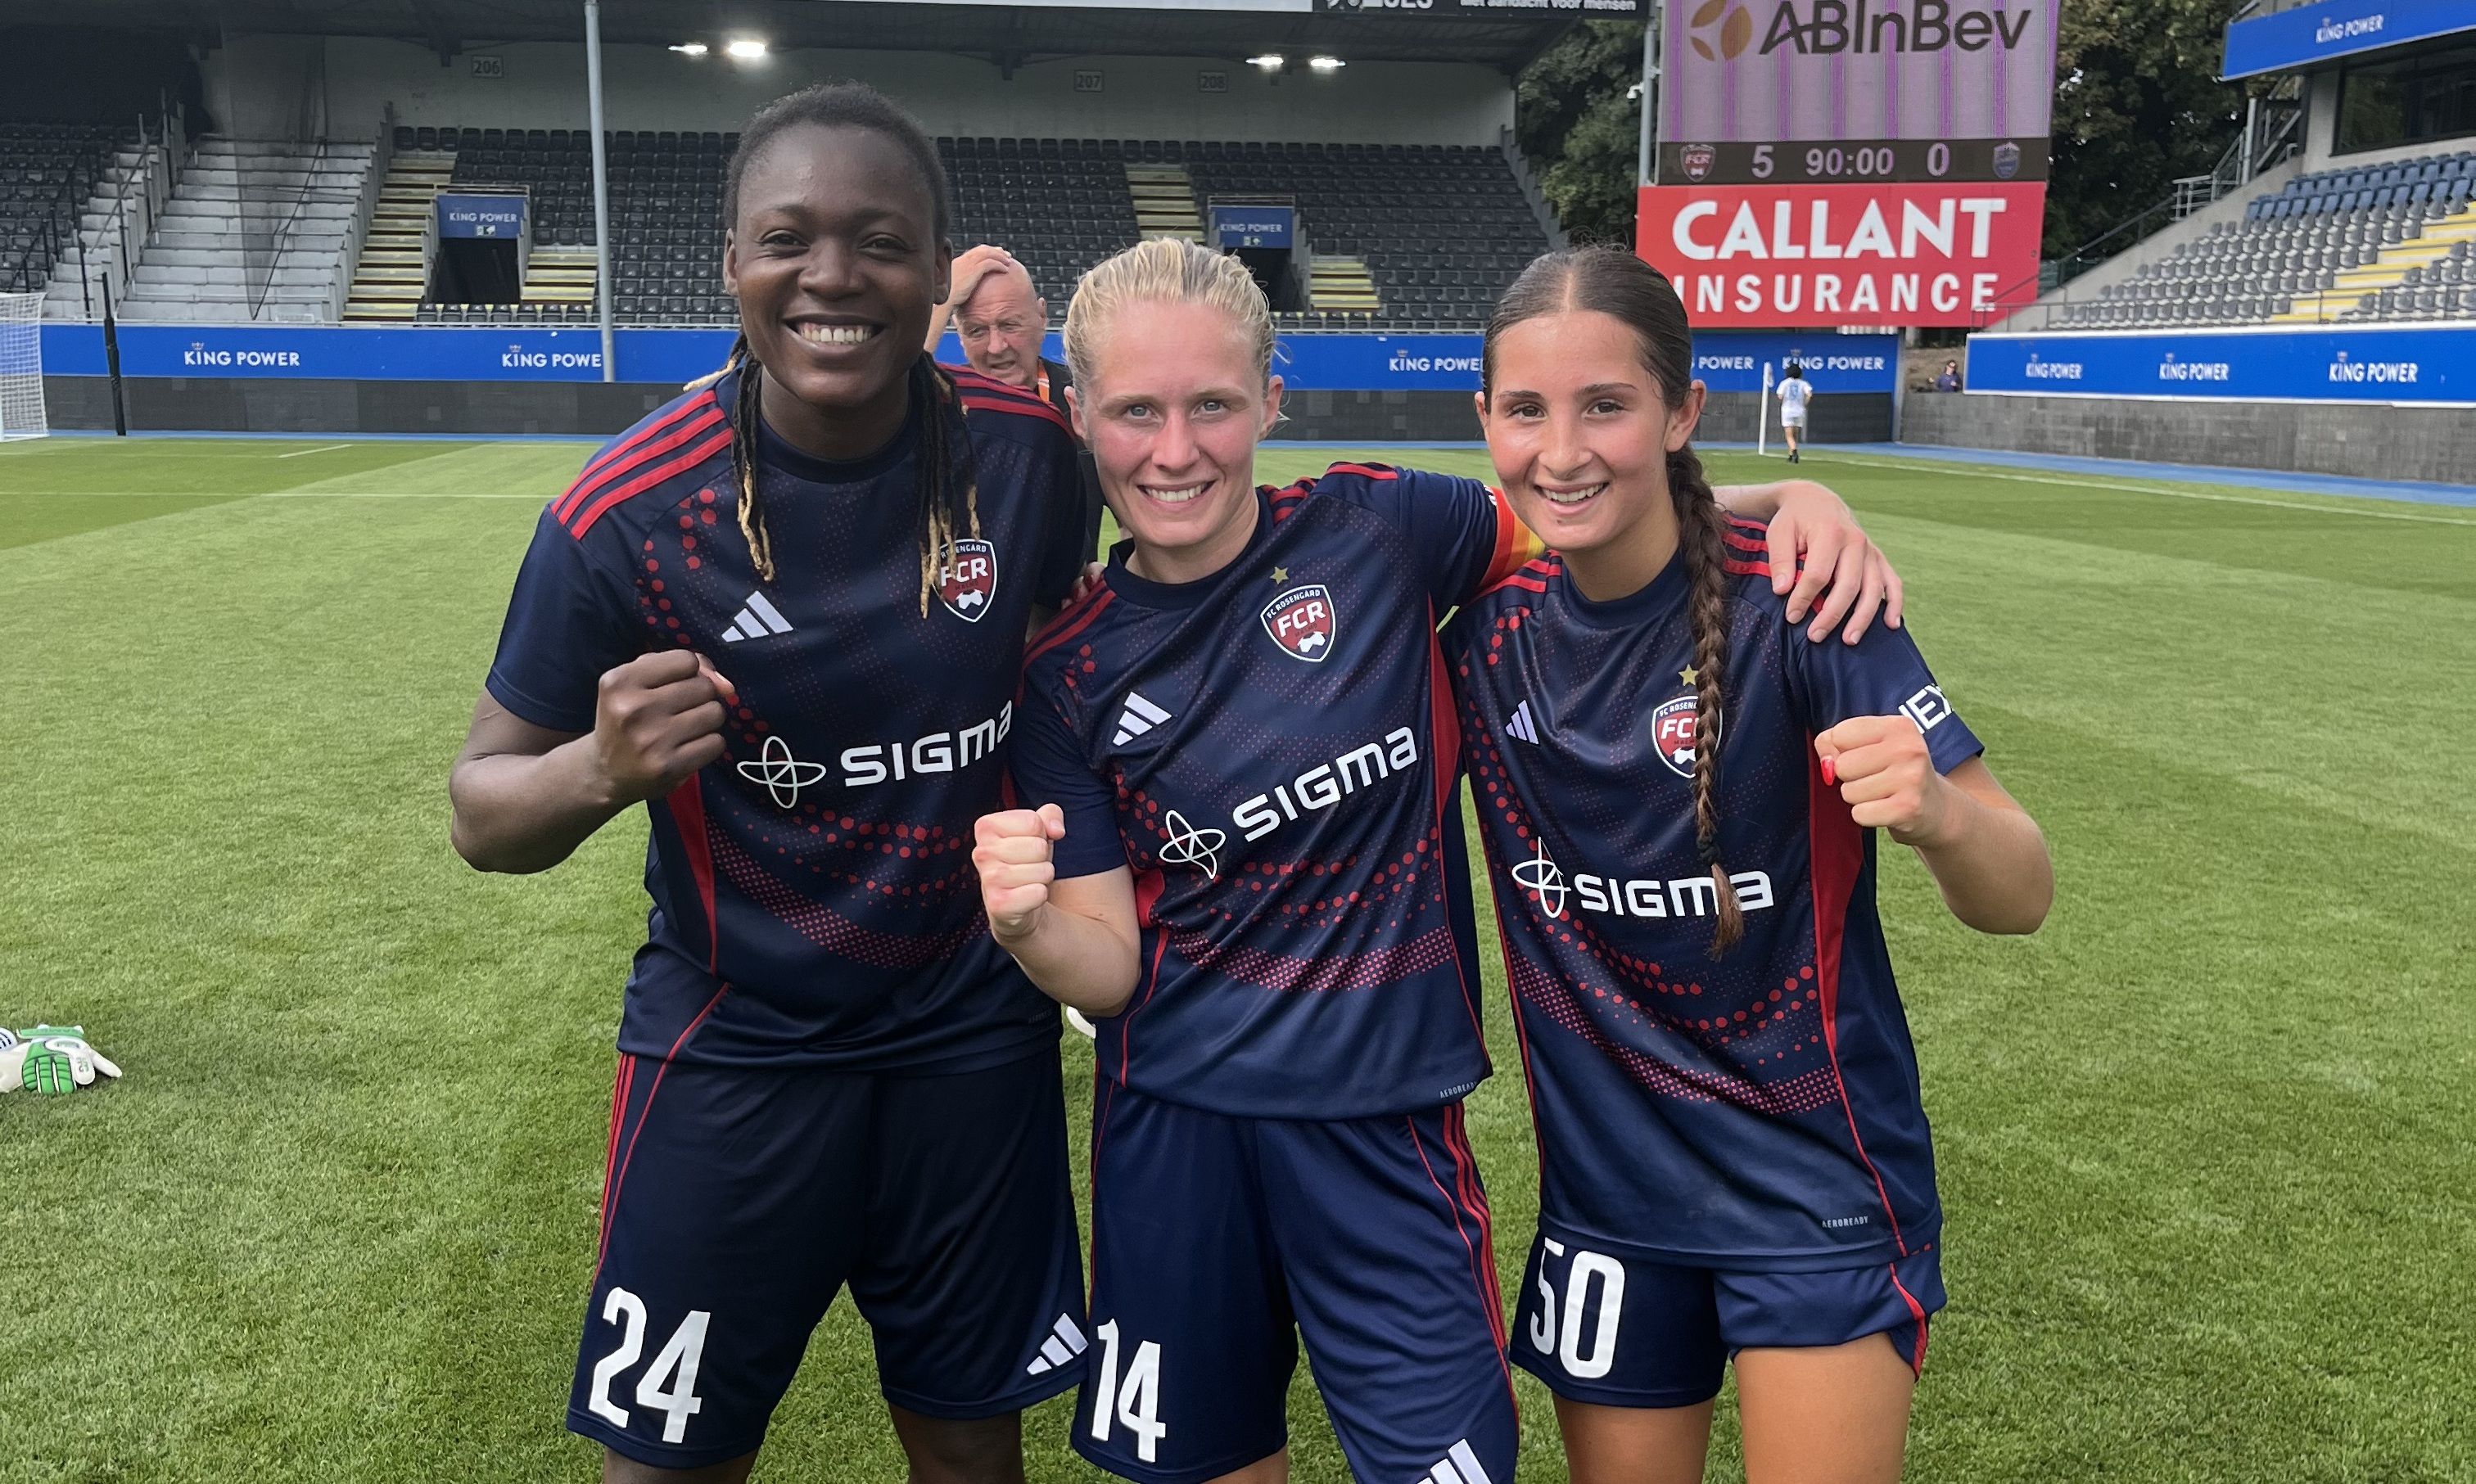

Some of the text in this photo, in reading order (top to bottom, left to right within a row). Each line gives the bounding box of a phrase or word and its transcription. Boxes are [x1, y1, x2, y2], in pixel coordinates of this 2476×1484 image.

[2316, 15, 2383, 43] KING POWER
[474, 61, 500, 74] 206
[1752, 143, 1950, 178] 5 90:00 0
[450, 213, 517, 223] KING POWER
[1248, 223, 1282, 232] POWER
[1673, 198, 2007, 260] CALLANT
[184, 351, 300, 366] KING POWER
[502, 353, 601, 368] KING POWE
[1389, 358, 1430, 372] KING
[1698, 356, 1754, 370] POWER
[1782, 356, 1884, 370] KING POWER
[2026, 363, 2082, 380] KING POWER
[2159, 363, 2229, 381] KING POWER
[2329, 363, 2418, 383] KING POWER
[941, 557, 988, 587] FCR
[1276, 601, 1326, 638] FCR
[1669, 701, 1697, 713] ROSEN
[1822, 1216, 1868, 1229] AEROREADY
[1529, 1237, 1625, 1378] 50
[588, 1287, 712, 1444] 24
[1091, 1318, 1167, 1464] 14
